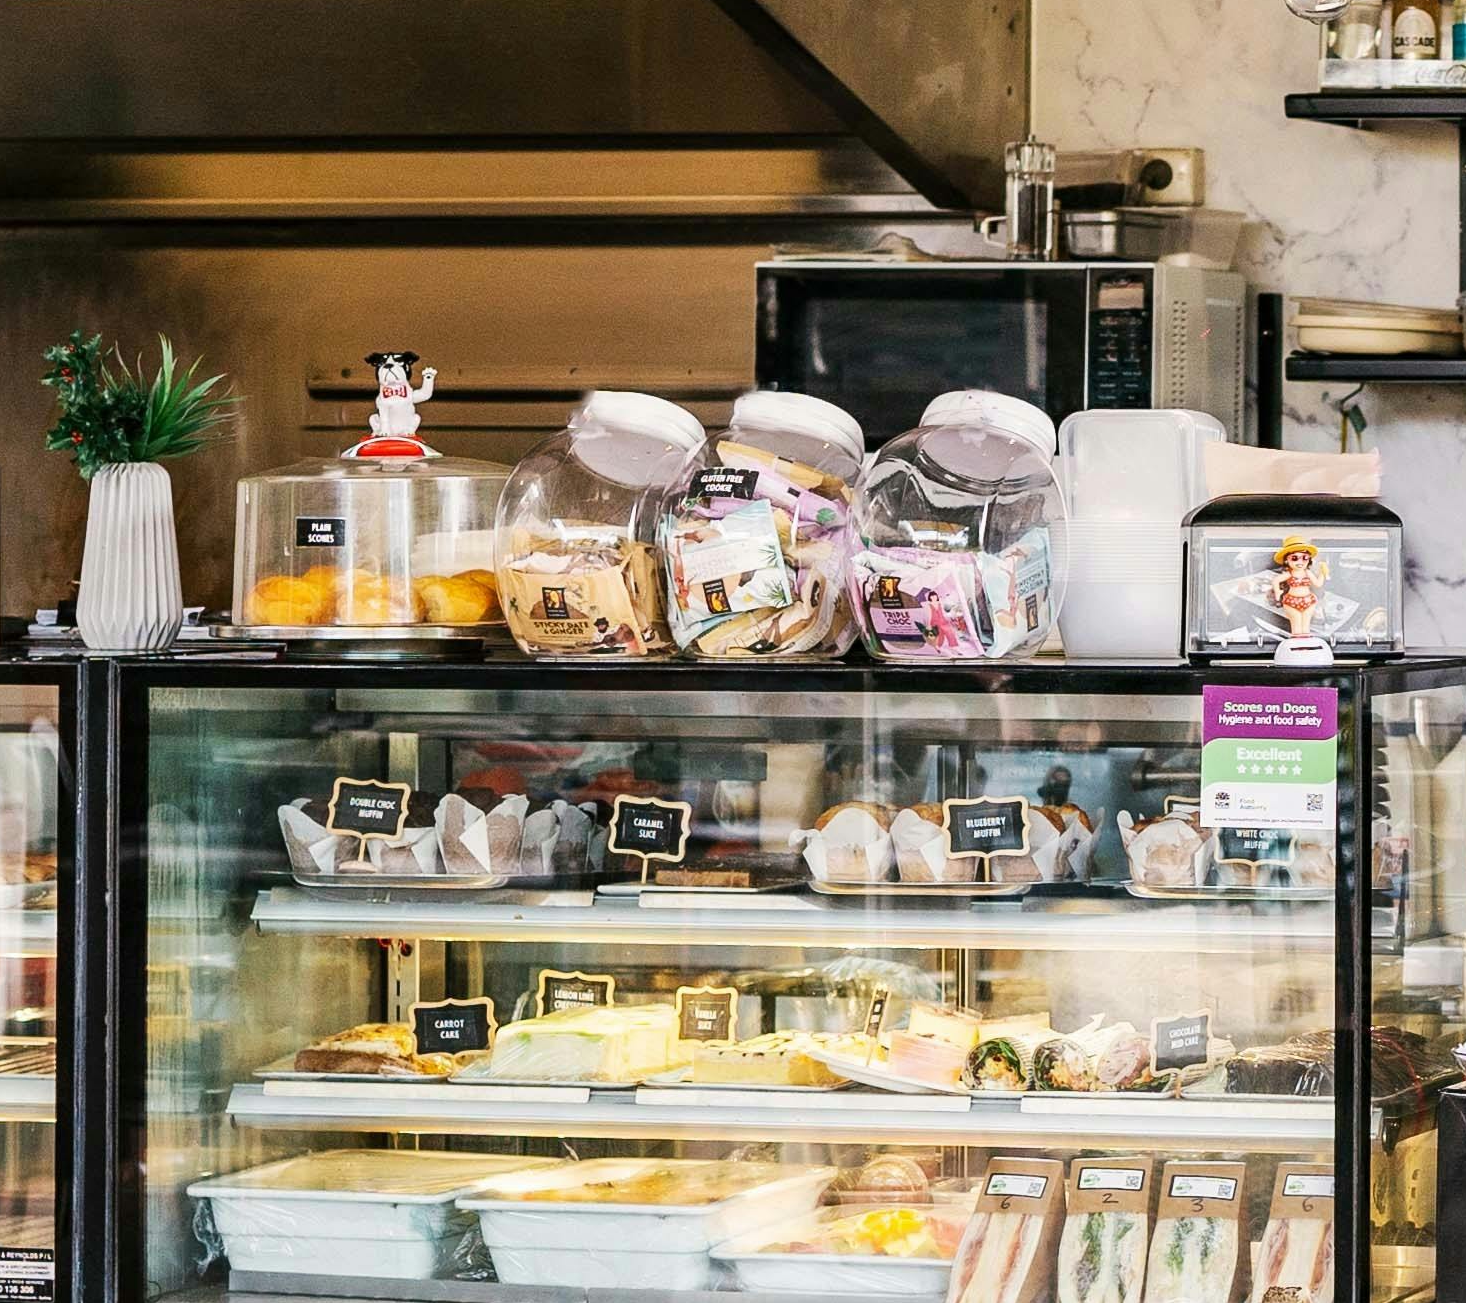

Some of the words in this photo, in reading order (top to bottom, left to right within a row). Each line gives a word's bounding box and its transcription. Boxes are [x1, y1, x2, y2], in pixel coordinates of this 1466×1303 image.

[1394, 36, 1435, 48] CASCADE
[701, 474, 726, 483] GLUTEN
[726, 475, 744, 484] FREE
[705, 483, 733, 493] COOKIE
[883, 611, 910, 619] TRIPLE
[534, 621, 565, 629] STICKY
[567, 621, 589, 629] DATE
[887, 618, 911, 626] CHOC
[1224, 701, 1263, 713] Scores
[1265, 703, 1279, 713] on
[1282, 703, 1317, 714] Doors
[1218, 714, 1253, 726] Hygiene
[1255, 715, 1272, 725] and
[1273, 715, 1294, 726] food
[1295, 716, 1323, 728] safety
[1236, 747, 1303, 762] Excellent
[349, 797, 376, 809] DOUBLE
[377, 799, 396, 810] CHOC
[358, 808, 384, 820] MUFFIN
[633, 818, 664, 830] CARAMEL
[966, 816, 1006, 828] BLUEBERRY
[638, 828, 658, 840] SLICE
[974, 828, 1001, 838] MUFFIN
[434, 1019, 464, 1029] CARROT
[440, 1030, 460, 1040] CAKE
[1000, 1195, 1011, 1210] 6
[1101, 1192, 1119, 1204] 2
[1191, 1198, 1205, 1213] 3
[1301, 1197, 1315, 1213] 6
